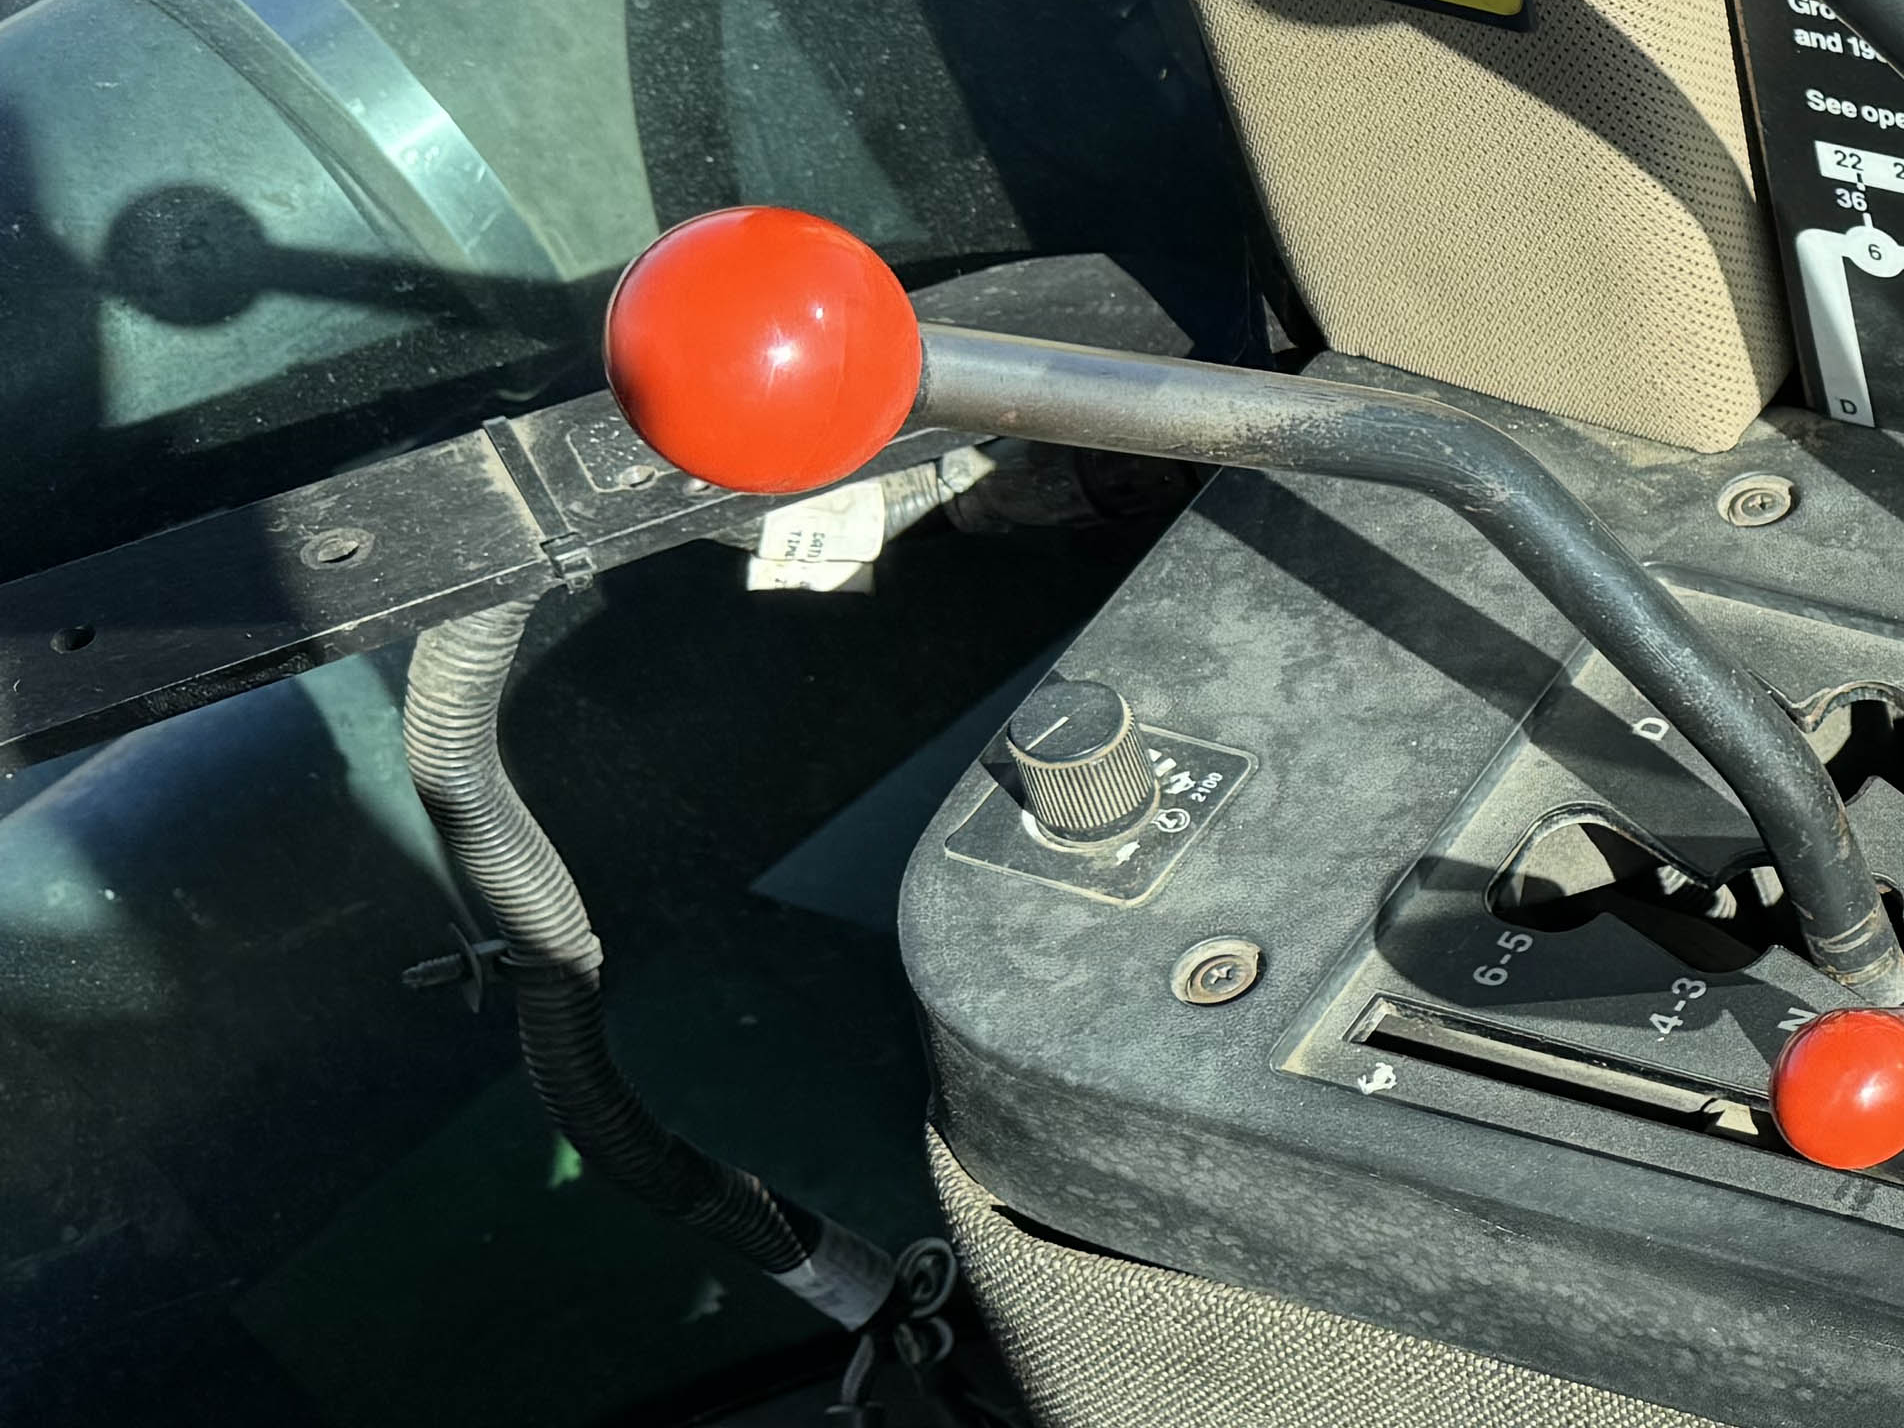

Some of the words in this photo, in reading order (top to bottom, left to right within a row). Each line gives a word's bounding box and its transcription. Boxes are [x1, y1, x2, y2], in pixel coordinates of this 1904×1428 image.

[1834, 149, 1864, 171] 22
[1835, 189, 1867, 212] 36
[1634, 717, 1669, 741] D
[1191, 772, 1224, 803] 2100
[1473, 929, 1534, 988] 6-5
[1650, 975, 1709, 1038] 4-3
